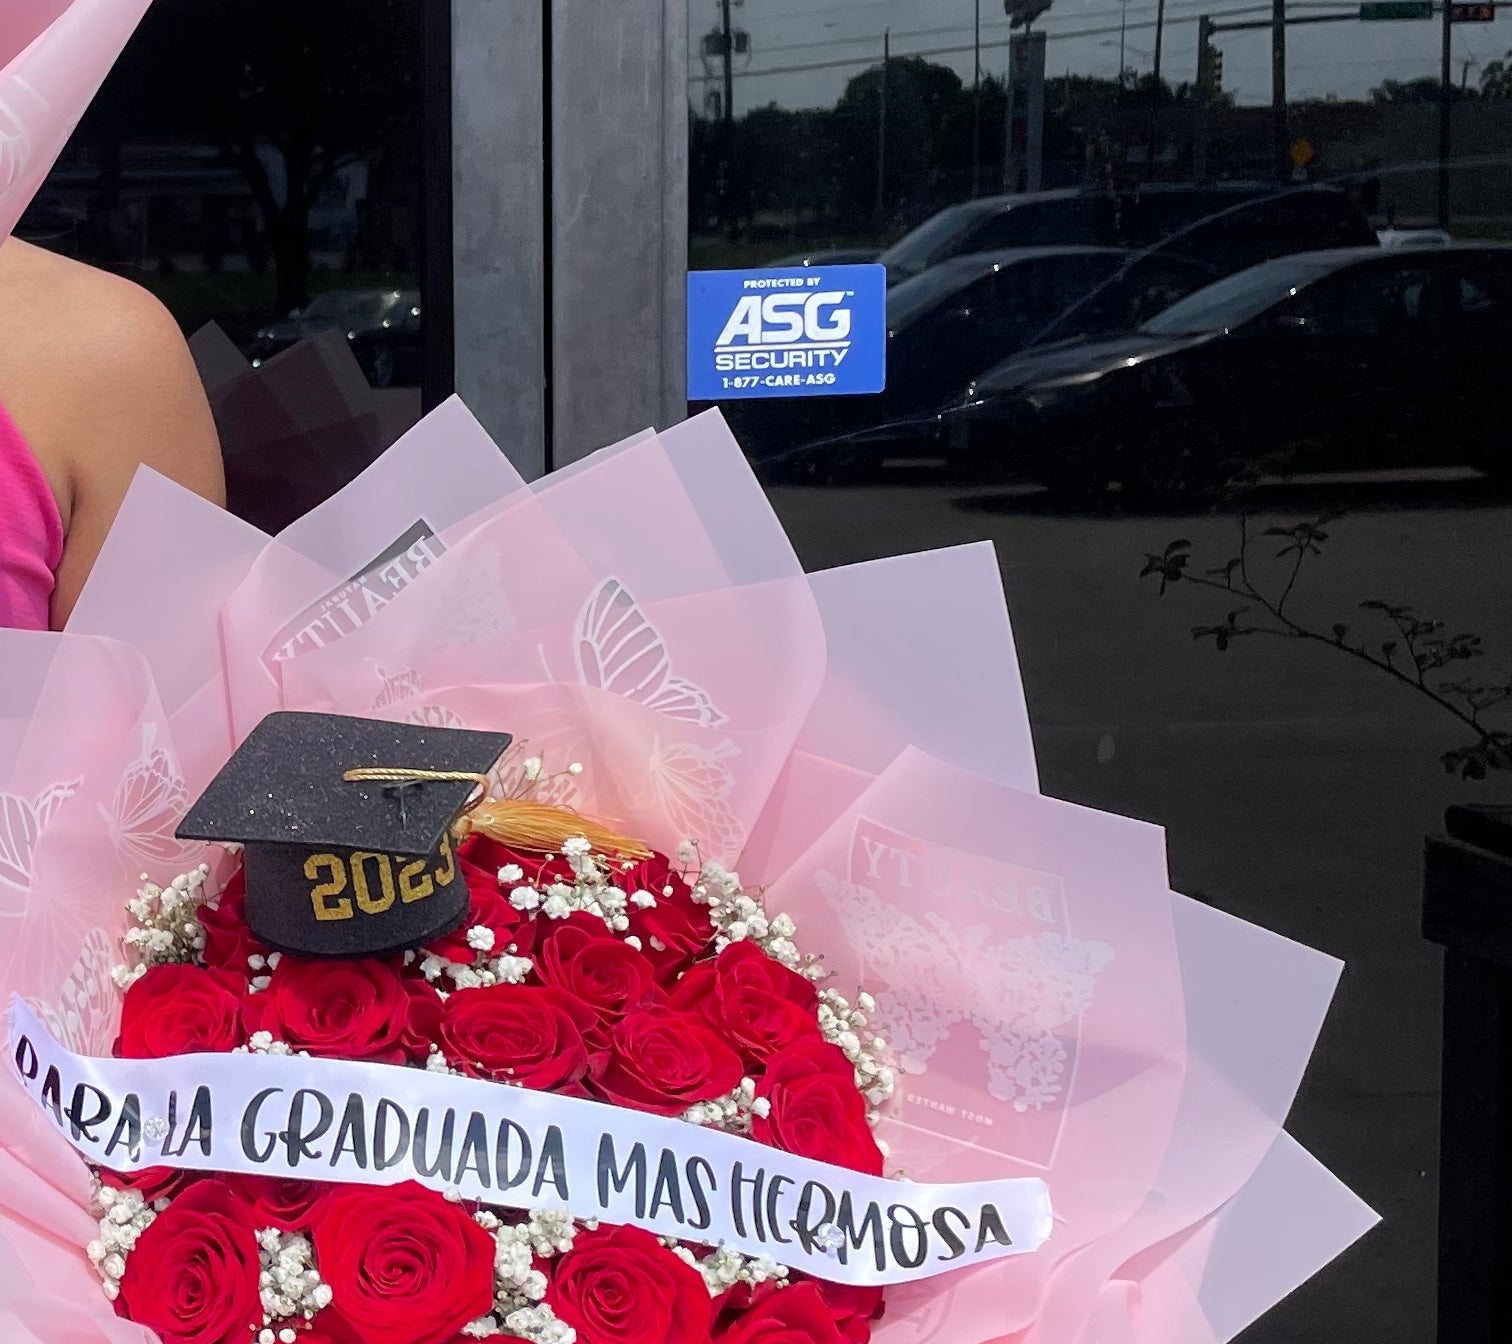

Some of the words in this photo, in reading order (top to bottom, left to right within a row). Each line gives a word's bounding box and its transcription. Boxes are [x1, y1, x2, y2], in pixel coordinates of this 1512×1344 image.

[743, 278, 803, 289] PROTECTED
[804, 277, 820, 287] BY
[715, 291, 851, 345] ASG
[715, 348, 848, 371] SECURITY
[722, 372, 836, 389] 1-877-CARE-ASG
[303, 831, 456, 921] 2023
[15, 1034, 141, 1162] PARA
[161, 1085, 213, 1156] LA
[241, 1084, 571, 1201] GRADUADA
[598, 1131, 713, 1229] MAS
[731, 1167, 1014, 1271] HERMOSA
